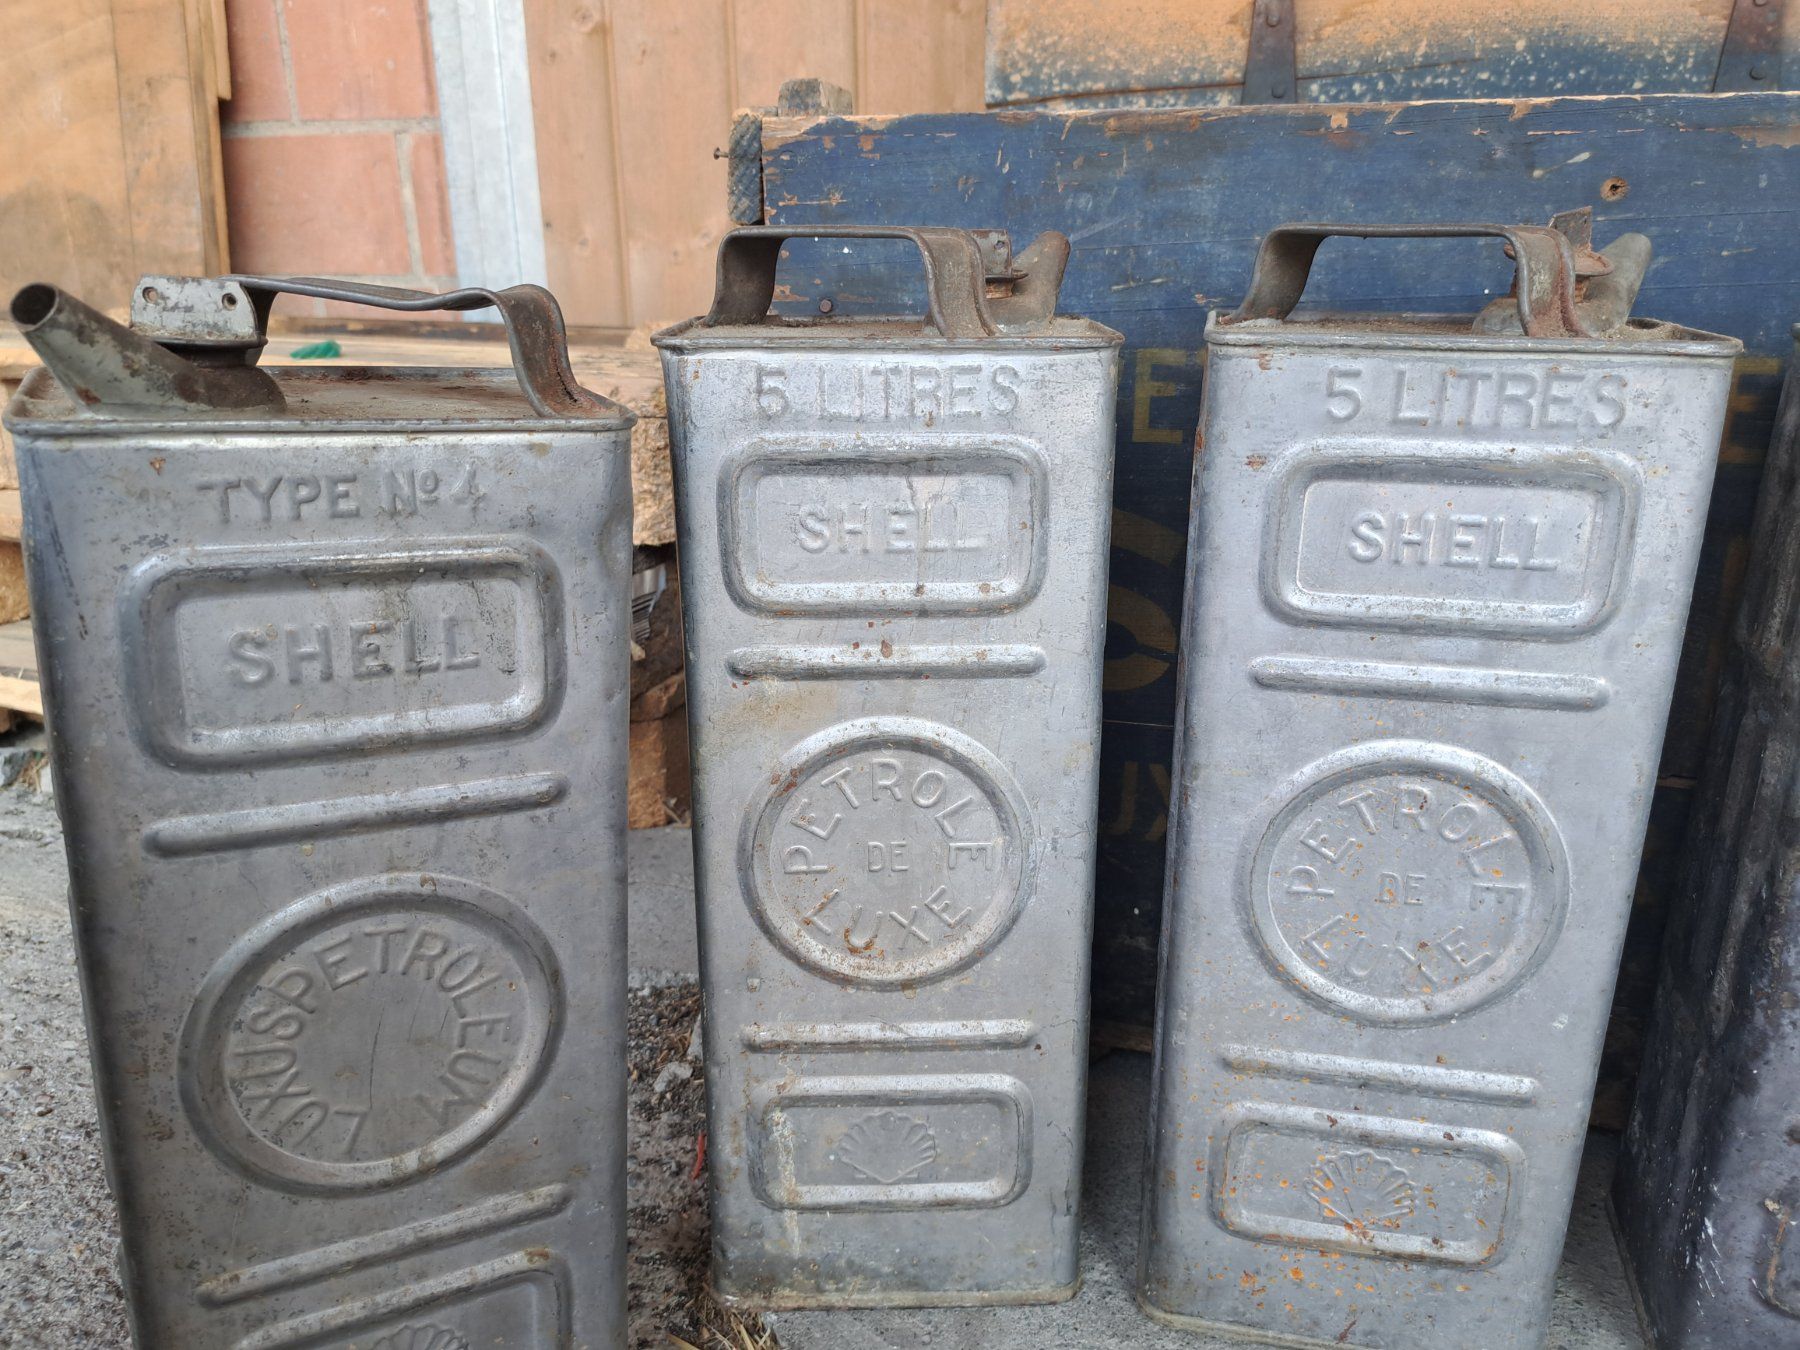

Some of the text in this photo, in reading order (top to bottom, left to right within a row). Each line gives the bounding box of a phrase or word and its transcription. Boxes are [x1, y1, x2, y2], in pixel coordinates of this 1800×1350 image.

[756, 363, 1022, 422] 5 LITRES
[1326, 364, 1626, 428] 5 LITRES
[196, 473, 361, 525] TYPE
[449, 462, 486, 524] 4
[797, 503, 990, 554] SHELL
[1348, 510, 1559, 572] SHELL
[222, 615, 482, 687] SHELL
[782, 758, 994, 875] PETROLE
[1286, 784, 1527, 912] PETROLE
[867, 841, 909, 872] DE
[1377, 871, 1426, 905] DE
[802, 885, 973, 951] LUXE
[1300, 914, 1492, 985] LUXE
